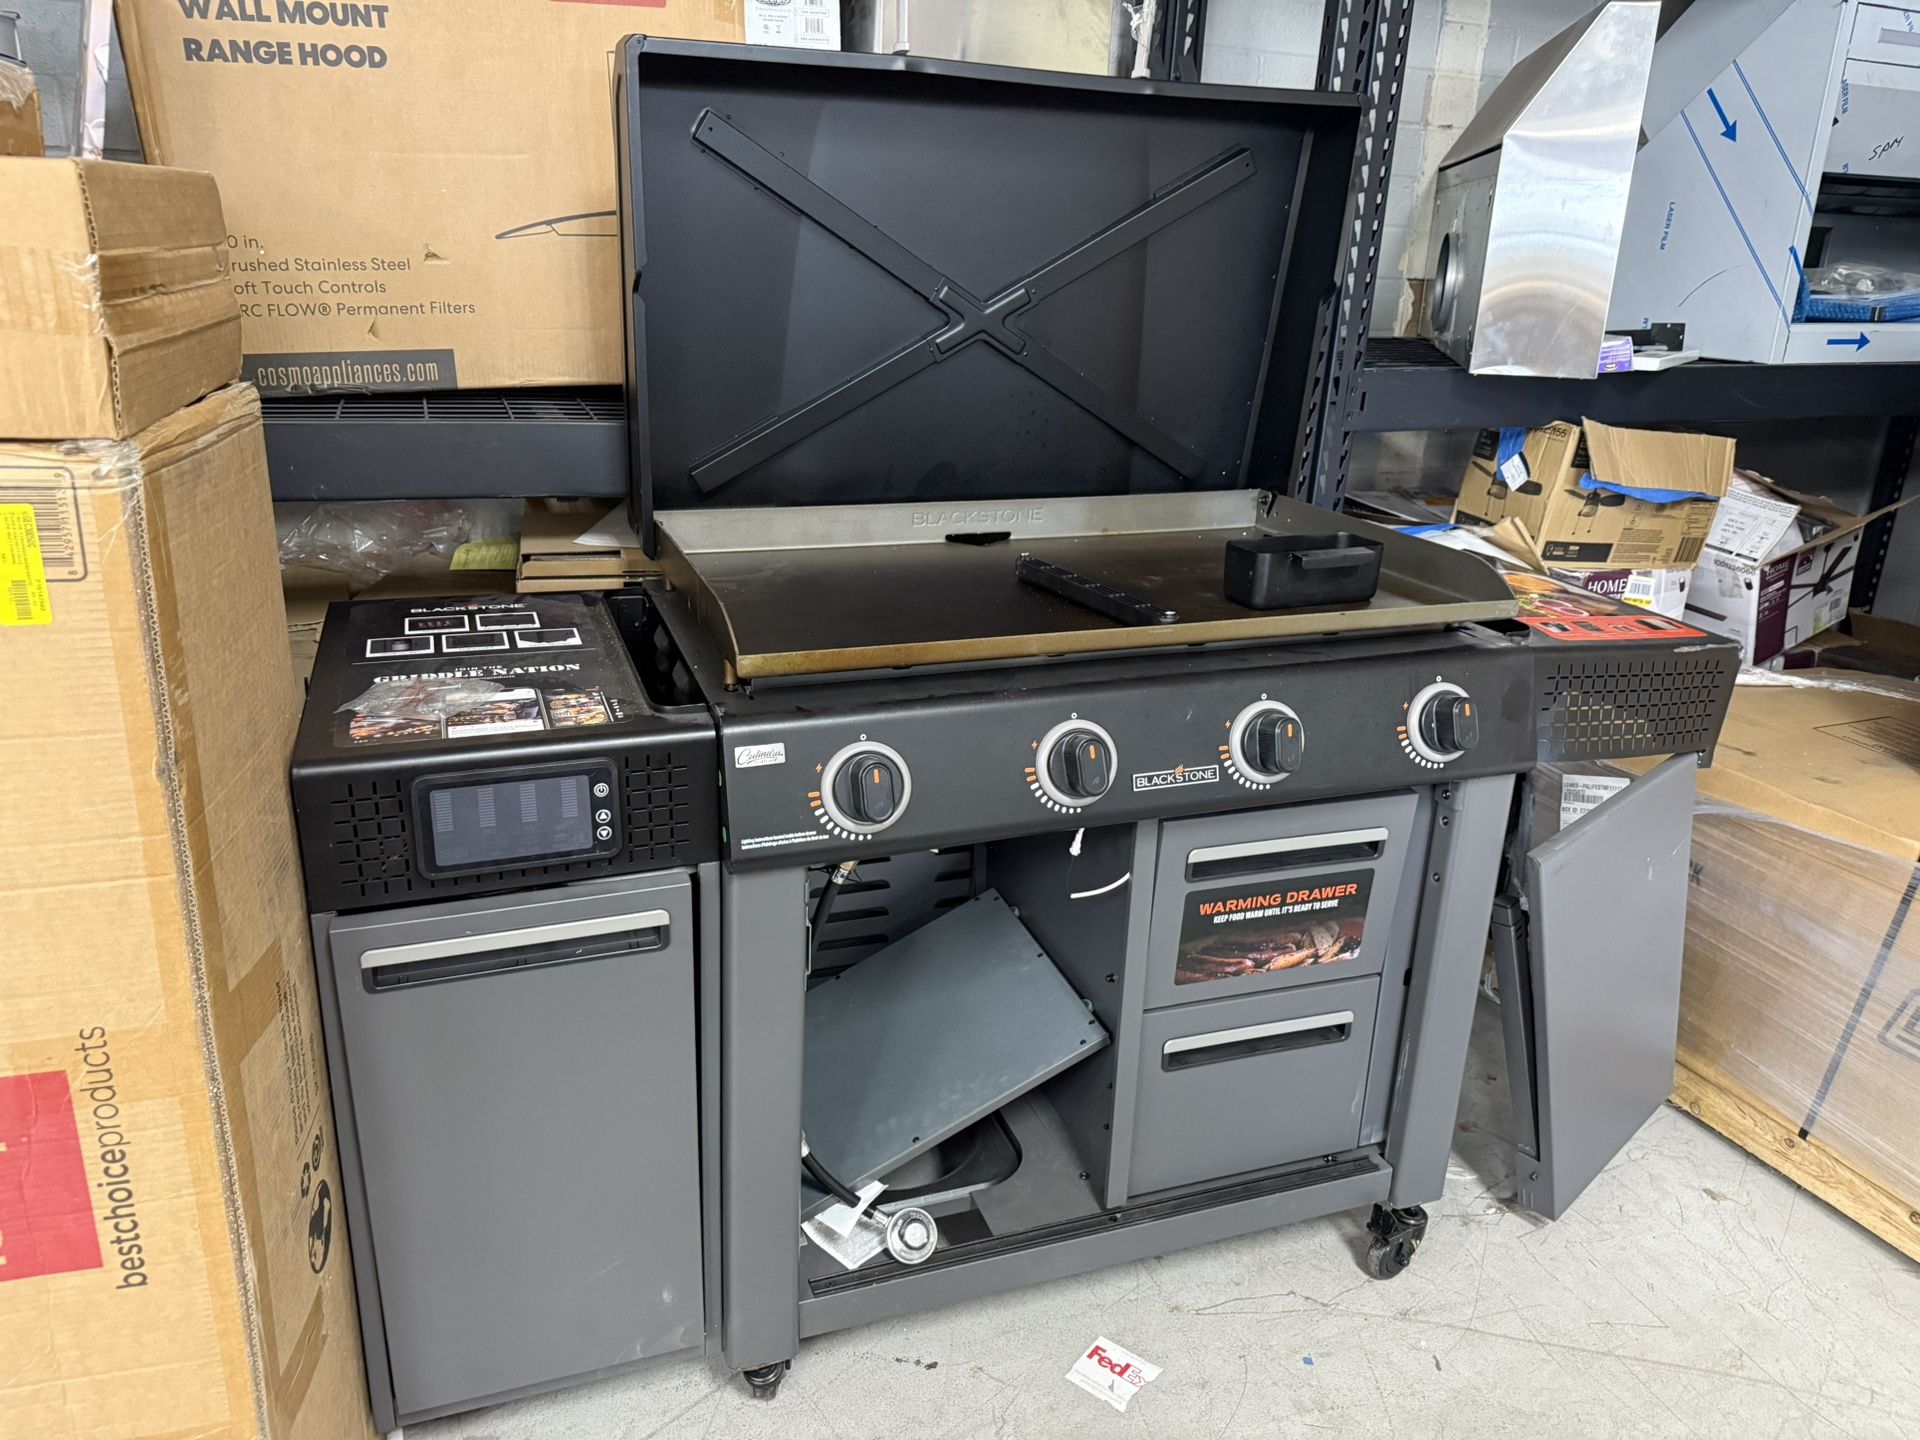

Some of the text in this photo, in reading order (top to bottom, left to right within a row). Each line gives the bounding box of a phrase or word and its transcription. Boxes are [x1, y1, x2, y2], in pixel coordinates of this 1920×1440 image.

[178, 0, 389, 28] WALL MOUNT
[182, 37, 388, 68] RANGE HOOD
[1659, 201, 1676, 250] LASER FILM
[243, 235, 264, 249] in.
[231, 257, 411, 272] rushed Stainless Steel
[233, 279, 387, 295] oft Touch Controls
[240, 303, 263, 317] RC
[337, 302, 425, 316] Permanent
[430, 300, 476, 314] Filters
[257, 359, 439, 391] cosmoappliances.com
[912, 507, 1044, 528] BLACKSTONE
[1588, 578, 1628, 593] HOME
[410, 602, 527, 614] BLACKSTONE
[493, 663, 581, 676] NATION
[1136, 768, 1216, 788] BLACKSTONE
[1200, 883, 1358, 915] WARMING DRAWER
[1213, 914, 1229, 924] KEEP
[1229, 911, 1245, 922] FOOD
[1294, 903, 1312, 913] READY
[1321, 899, 1339, 908] SERVE
[74, 1026, 148, 1289] bestchoiceproducts
